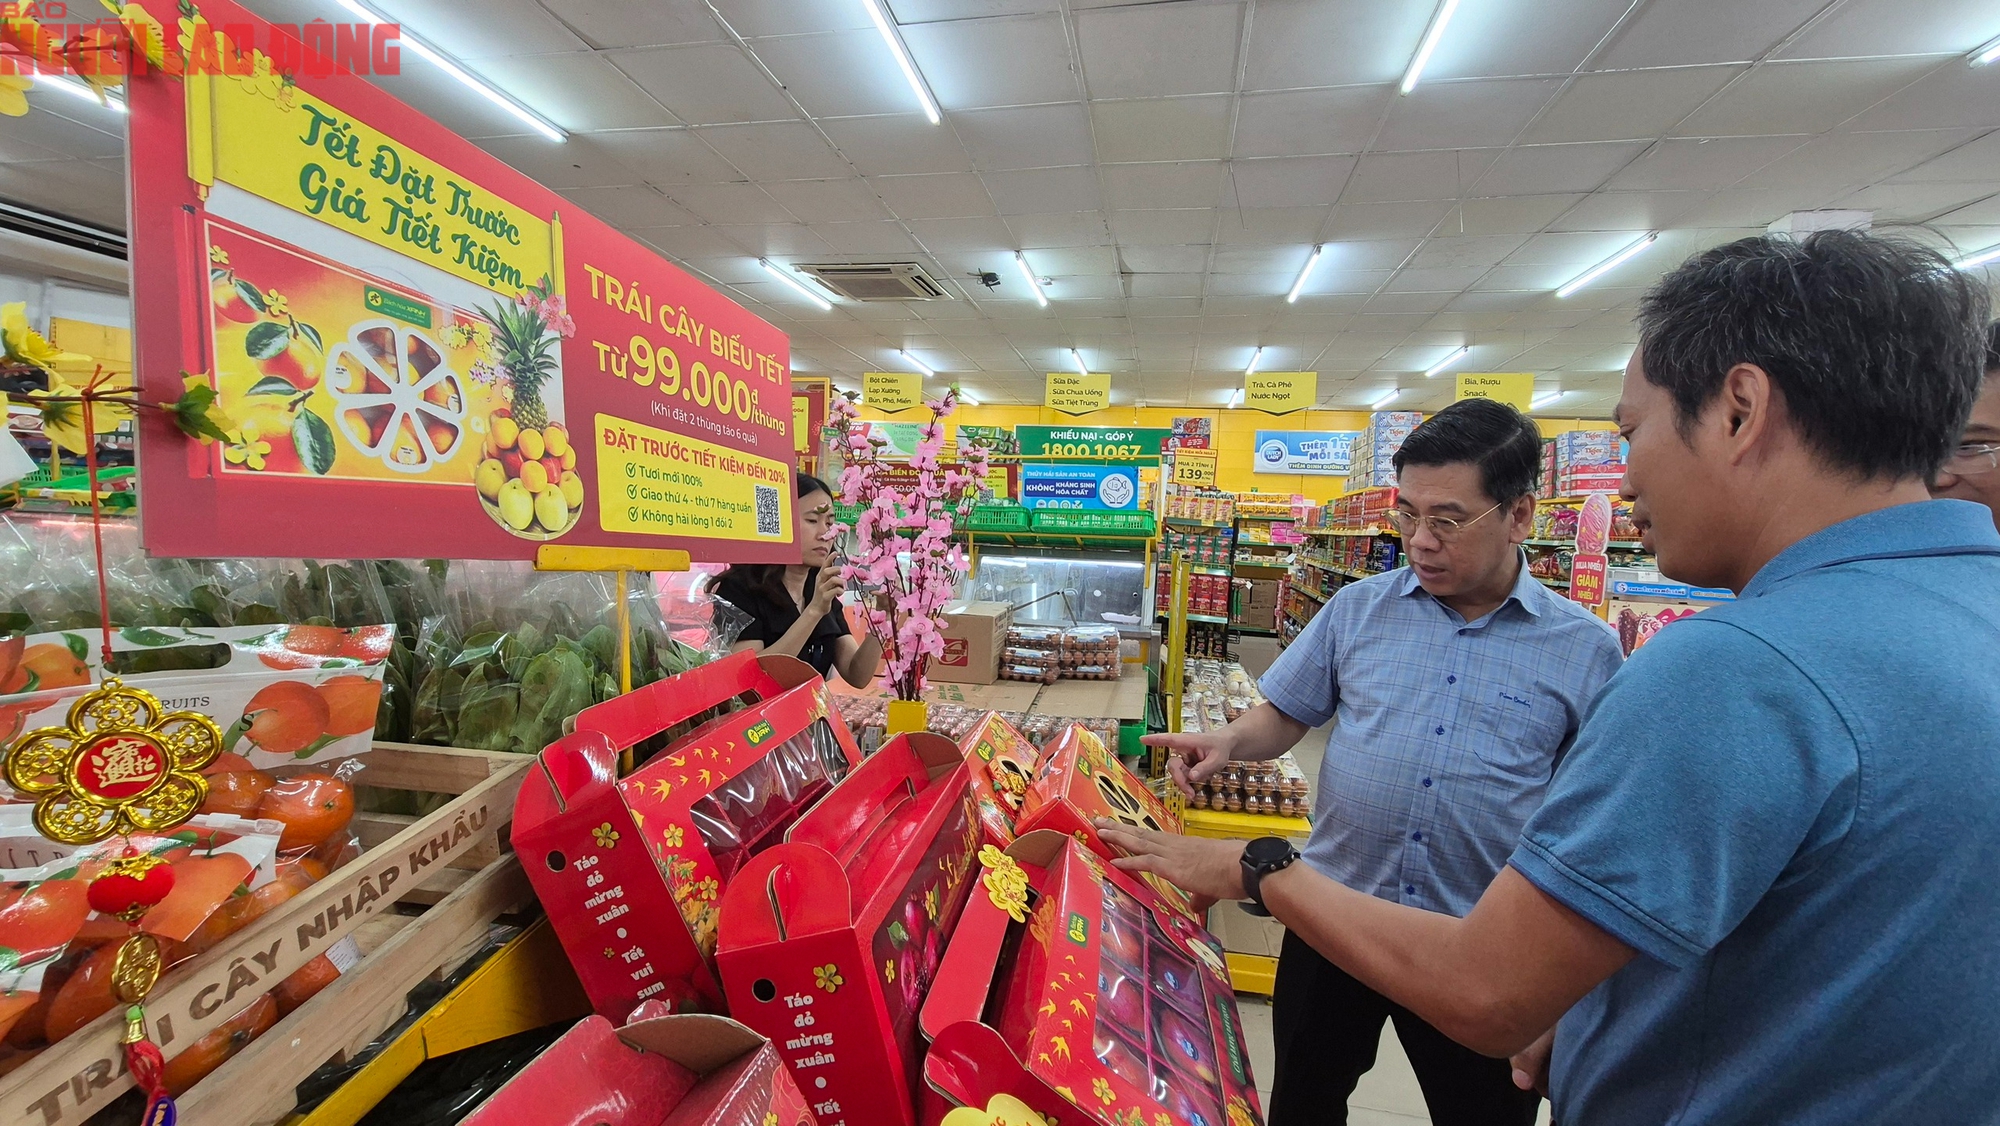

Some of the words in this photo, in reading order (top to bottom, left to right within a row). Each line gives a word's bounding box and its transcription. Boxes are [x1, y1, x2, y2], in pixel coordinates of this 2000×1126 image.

[299, 103, 362, 168] Tết
[370, 144, 437, 207] Đặt
[445, 180, 521, 246] Trước
[299, 162, 370, 224] Giá
[381, 196, 443, 255] Tiết
[451, 233, 525, 287] Kiệm
[583, 263, 652, 324] TRÁI
[659, 304, 705, 347] CÂY
[709, 328, 753, 371] BIẾU
[756, 352, 785, 386] TẾT
[629, 334, 752, 421] 99.000
[651, 400, 671, 418] (Khi
[672, 408, 688, 424] đặt
[689, 413, 696, 426] 2
[696, 416, 721, 436] thùng
[722, 424, 736, 437] táo
[736, 428, 741, 439] 6
[1050, 429, 1080, 440] KHIẾU
[1081, 431, 1097, 442] NẠI
[1105, 431, 1125, 441] GÓP
[1127, 431, 1134, 441] Ý
[1301, 441, 1328, 450] THÊM
[1331, 438, 1339, 448] 1
[603, 427, 638, 454] ĐẶT
[640, 437, 689, 462] TRƯỚC
[692, 448, 716, 468] TIẾT
[719, 456, 745, 477] KIỆM
[747, 461, 767, 480] ĐẾN
[768, 468, 786, 484] 20%
[1041, 443, 1090, 458] 1800
[1094, 444, 1142, 461] 1067
[1309, 449, 1331, 460] MỖI
[1334, 451, 1350, 460] SÁ
[639, 465, 660, 481] Tươi
[662, 471, 680, 484] mới
[681, 473, 702, 487] 100%
[1178, 468, 1202, 480] 139
[1026, 483, 1055, 491] KHÔNG
[640, 487, 662, 501] Giao
[664, 492, 681, 504] thứ
[682, 494, 689, 504] 4
[695, 495, 709, 507] thứ
[711, 498, 715, 507] 7
[717, 498, 736, 513] hàng
[641, 508, 674, 526] Không
[675, 510, 689, 523] hài
[691, 513, 708, 528] lòng
[710, 516, 713, 527] 1
[728, 519, 733, 528] 2
[161, 696, 210, 709] RUITS
[573, 855, 599, 872] Táo
[586, 870, 604, 888] đỏ
[584, 885, 624, 910] mừng
[596, 904, 630, 925] xuân
[621, 945, 645, 964] Tết
[26, 1013, 174, 1126] TRI
[189, 937, 284, 1022] CÂY
[297, 865, 401, 952] NHẬP
[407, 805, 488, 875] KHẨU
[630, 962, 654, 981] vui
[636, 981, 665, 1000] sum
[784, 992, 814, 1008] Táo
[794, 1011, 815, 1028] đỏ
[786, 1032, 834, 1050] mừng
[795, 1051, 835, 1069] xuân
[814, 1098, 841, 1116] Tết
